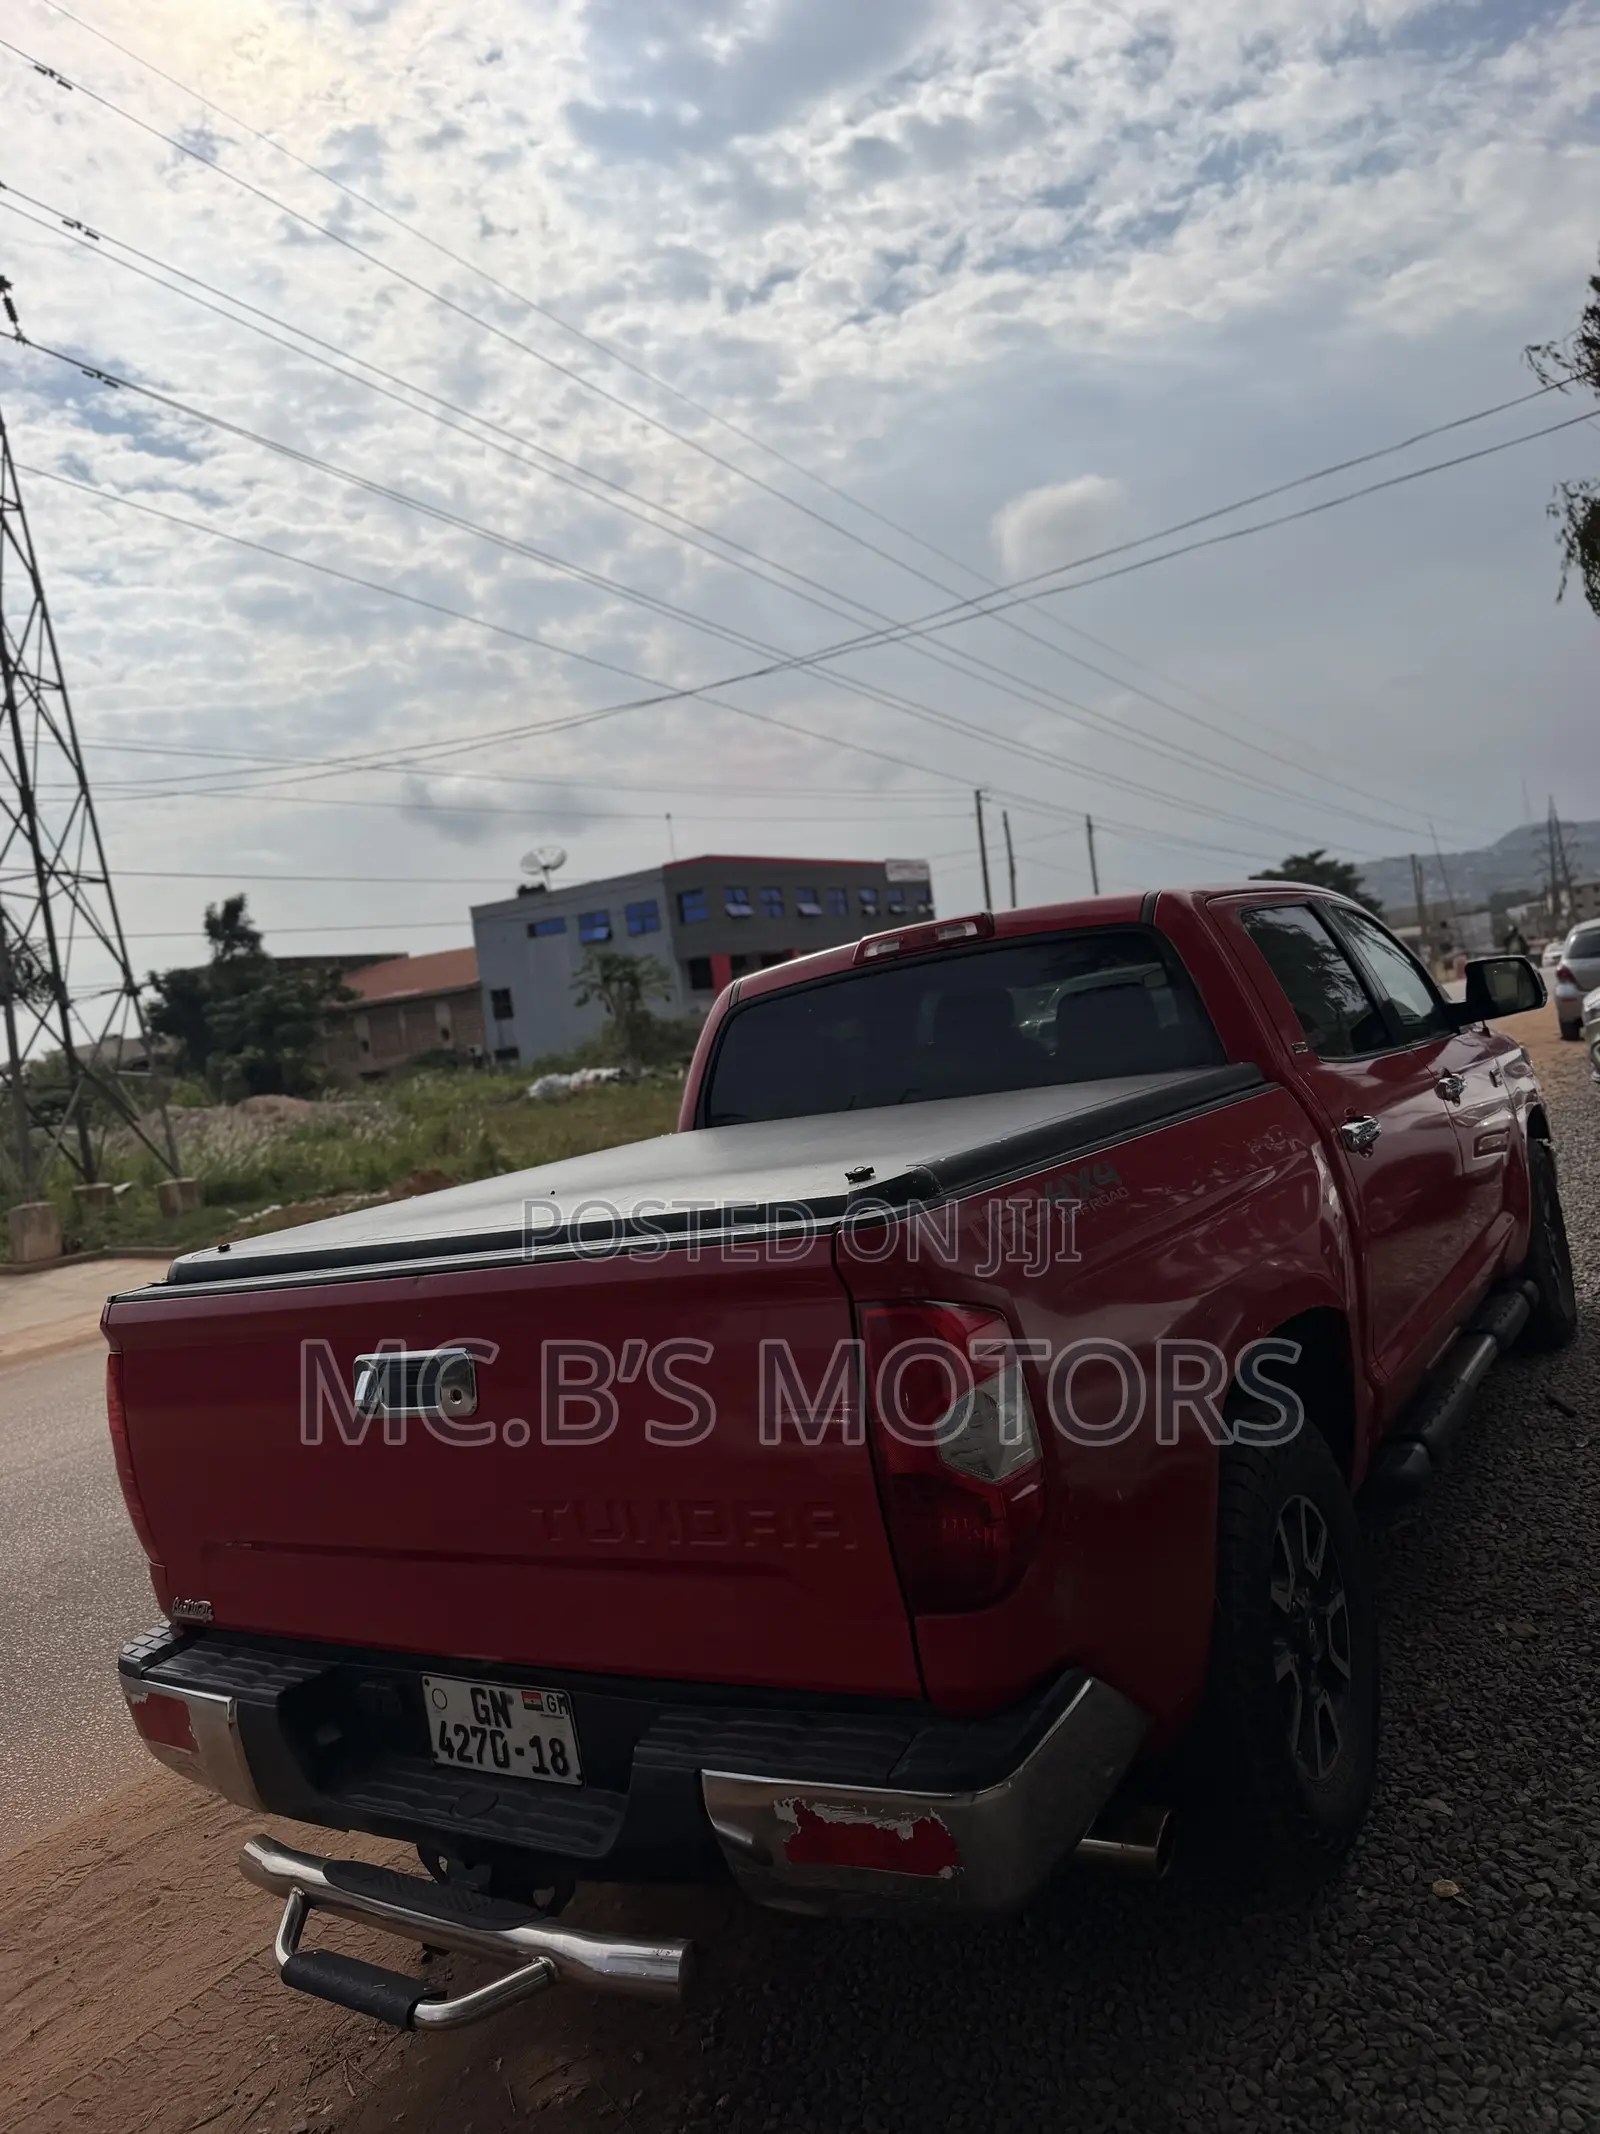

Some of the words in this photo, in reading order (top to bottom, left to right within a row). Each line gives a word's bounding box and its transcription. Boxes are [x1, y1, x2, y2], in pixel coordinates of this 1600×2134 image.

[525, 1500, 858, 1550] TUNDRA
[470, 1687, 512, 1728] GN
[439, 1721, 570, 1776] 4270-18
